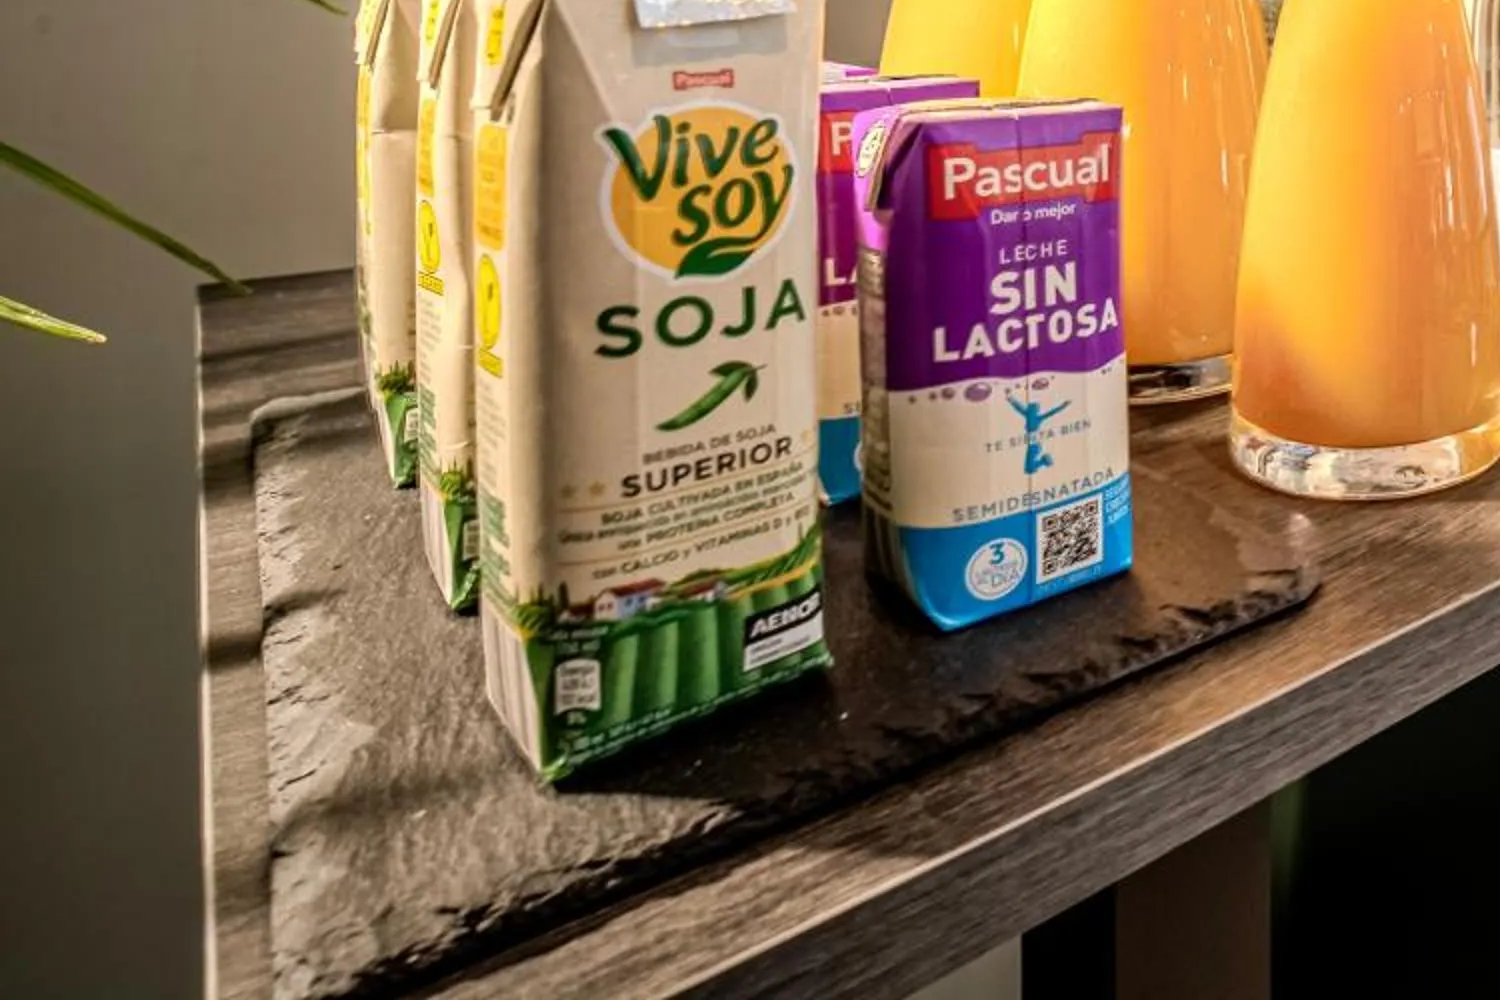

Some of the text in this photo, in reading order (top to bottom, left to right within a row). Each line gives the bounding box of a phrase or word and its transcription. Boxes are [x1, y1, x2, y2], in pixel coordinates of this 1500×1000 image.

[602, 115, 780, 202] Vive
[943, 143, 1111, 201] Pascual
[671, 163, 793, 246] soy
[991, 208, 1019, 225] Dar
[1035, 203, 1077, 220] mejor
[1000, 239, 1069, 265] LECHE
[990, 261, 1077, 315] SIN
[594, 278, 806, 358] SOJA
[933, 297, 1119, 363] LACTOSA
[642, 424, 776, 465] BEBIDA DE SOJA
[985, 441, 1003, 453] TE
[1061, 419, 1091, 436] BIEN
[620, 436, 793, 498] SUPERIOR
[601, 507, 642, 526] SOJA
[648, 485, 731, 515] CULTIVADA
[952, 467, 1115, 522] SEMIDESNATADA
[620, 549, 680, 573] CALCIO
[694, 522, 770, 552] VITAMINAS
[989, 543, 1005, 565] 3
